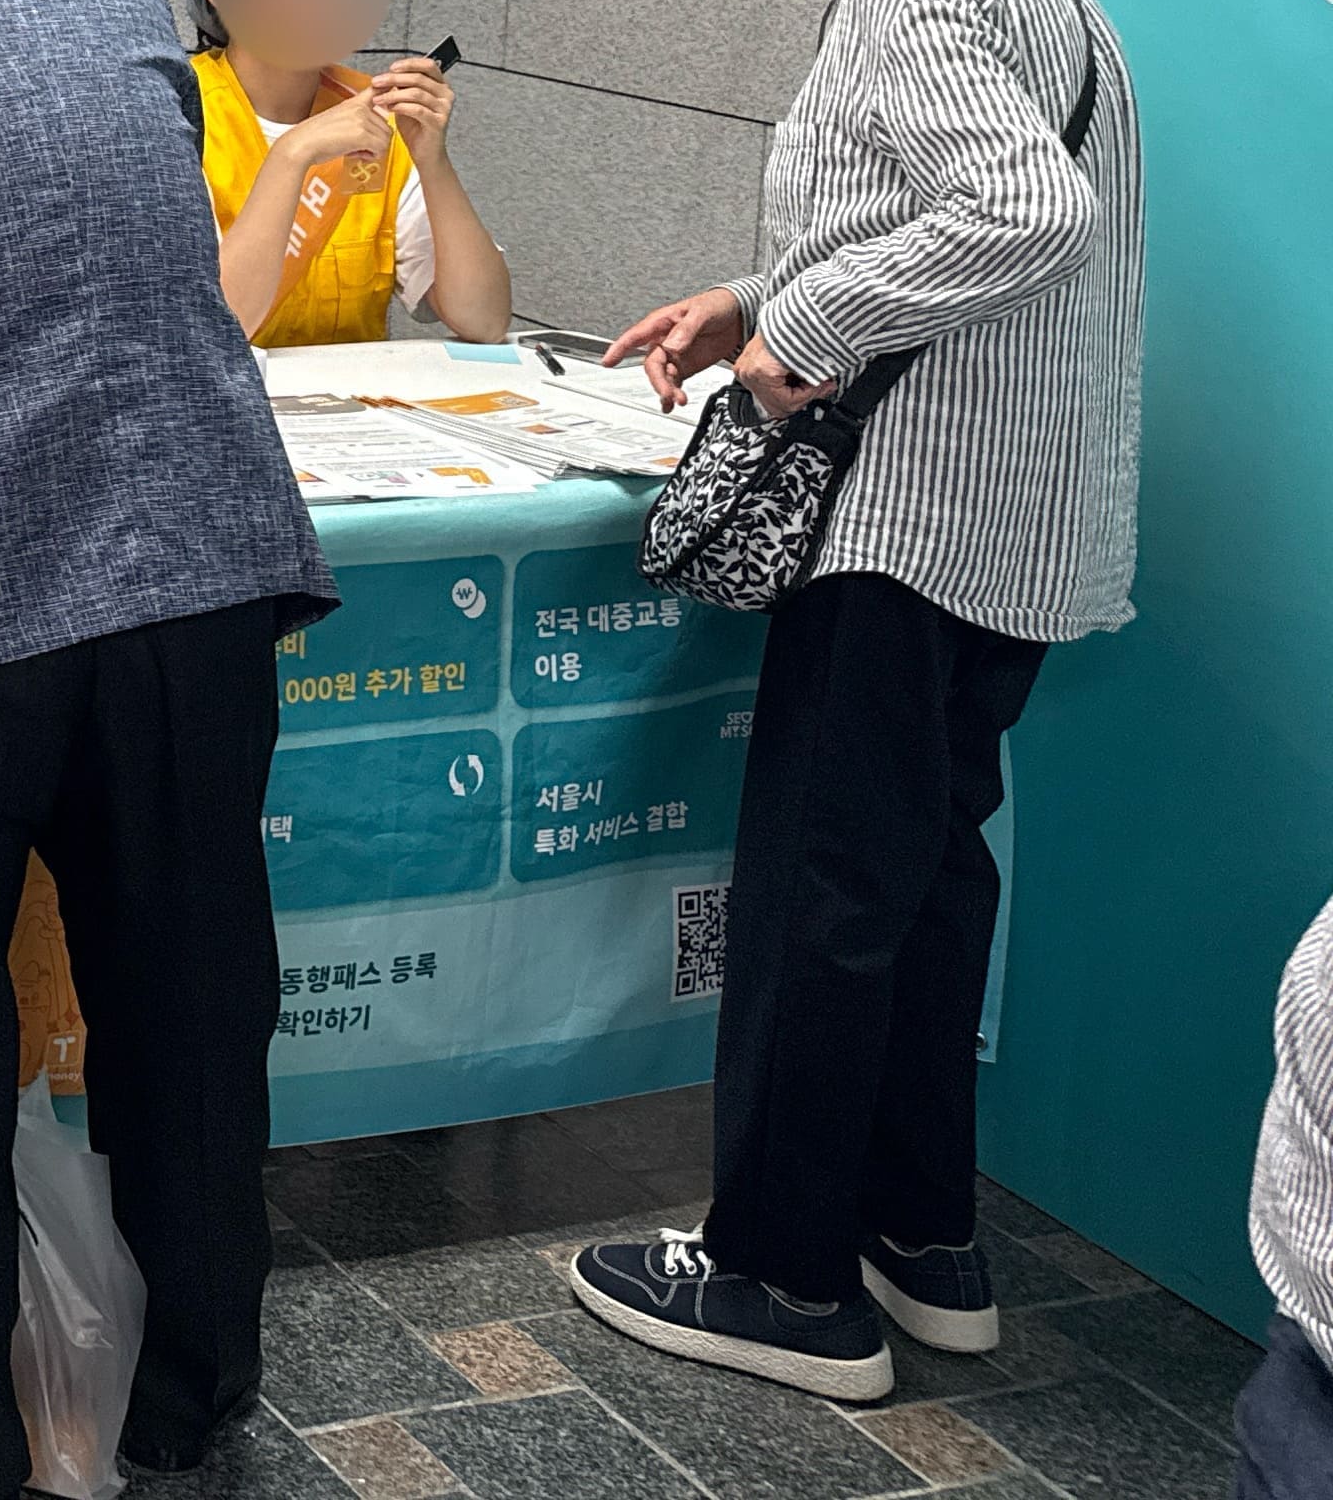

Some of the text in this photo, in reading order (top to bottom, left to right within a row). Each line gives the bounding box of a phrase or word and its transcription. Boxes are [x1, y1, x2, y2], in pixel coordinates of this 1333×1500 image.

[535, 598, 682, 637] 전국 대중교통
[365, 667, 413, 697] 추가
[420, 663, 465, 693] 할인
[535, 652, 582, 682] 이용
[536, 780, 603, 812] 서울시
[534, 801, 688, 855] 특화 서비스 결합
[390, 952, 437, 984] 등록
[277, 1005, 370, 1037] 확인하기
